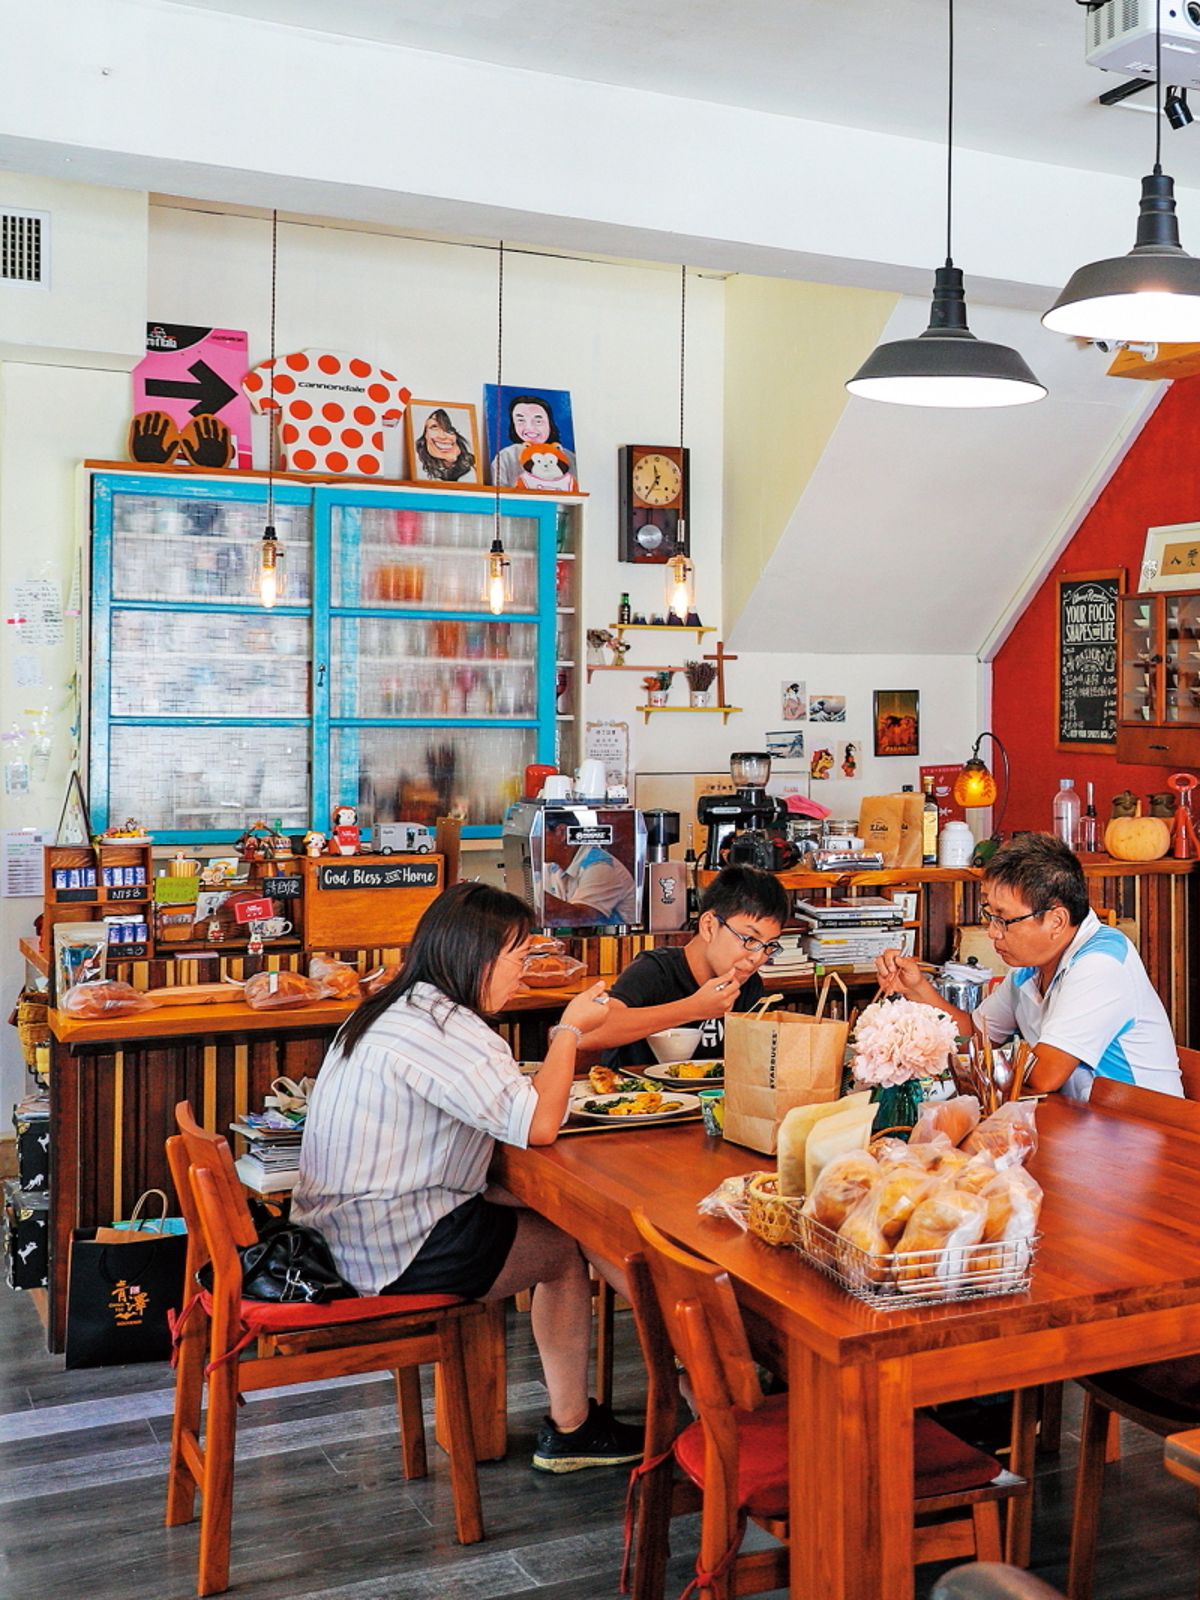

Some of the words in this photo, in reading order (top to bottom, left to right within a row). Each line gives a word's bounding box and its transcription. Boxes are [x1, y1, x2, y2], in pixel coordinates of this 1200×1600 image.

[298, 382, 365, 393] cannondale
[1066, 605, 1087, 623] YOUR
[1088, 603, 1115, 622] FOCUS
[1066, 624, 1092, 642] SHAPES
[1100, 622, 1115, 640] LIFE
[325, 869, 350, 885] God
[353, 869, 382, 885] Bless
[403, 867, 435, 882] Home
[769, 1033, 777, 1089] STARBUCKS
